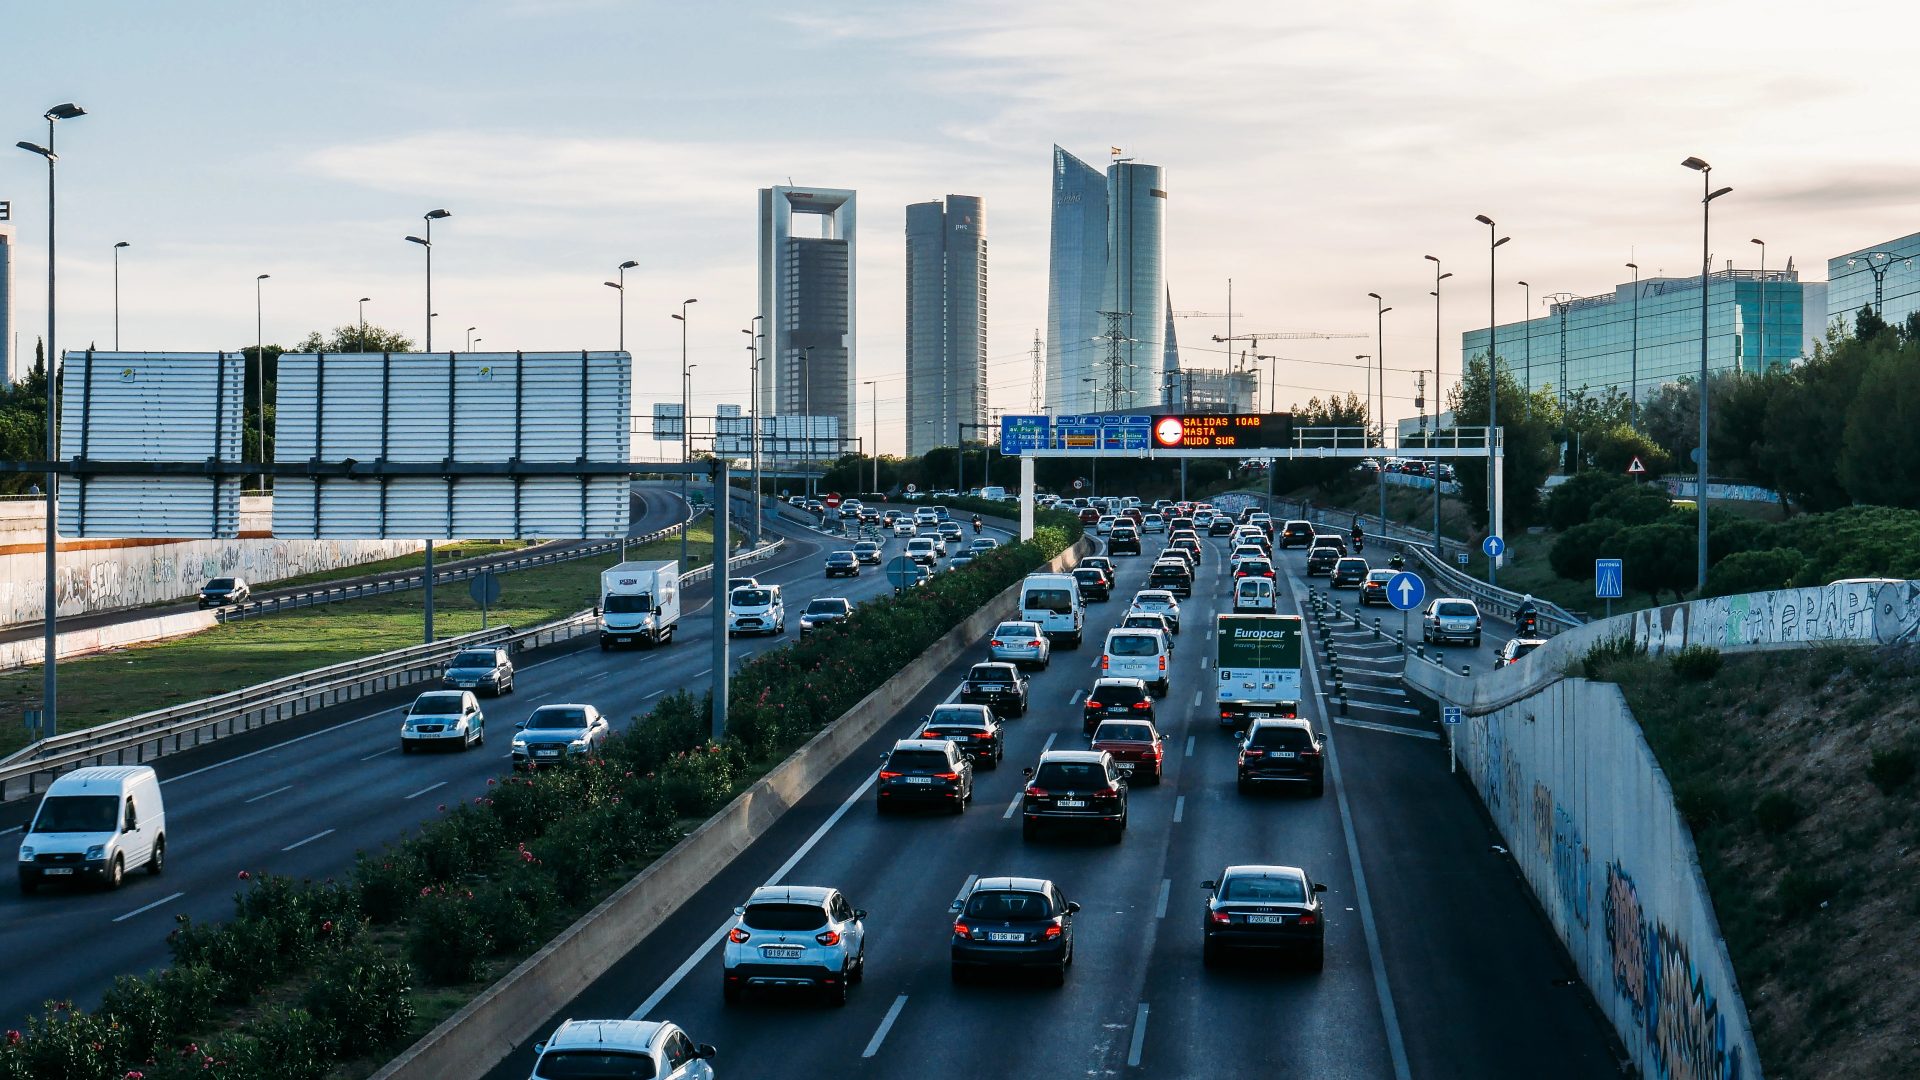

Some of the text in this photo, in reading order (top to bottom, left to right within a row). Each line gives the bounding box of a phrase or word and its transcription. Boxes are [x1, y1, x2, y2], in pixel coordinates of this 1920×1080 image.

[1183, 417, 1260, 426] SALIDAS 10AB
[1183, 436, 1235, 445] NUDO SUR
[1234, 628, 1286, 640] Europcar
[1449, 715, 1456, 723] 6
